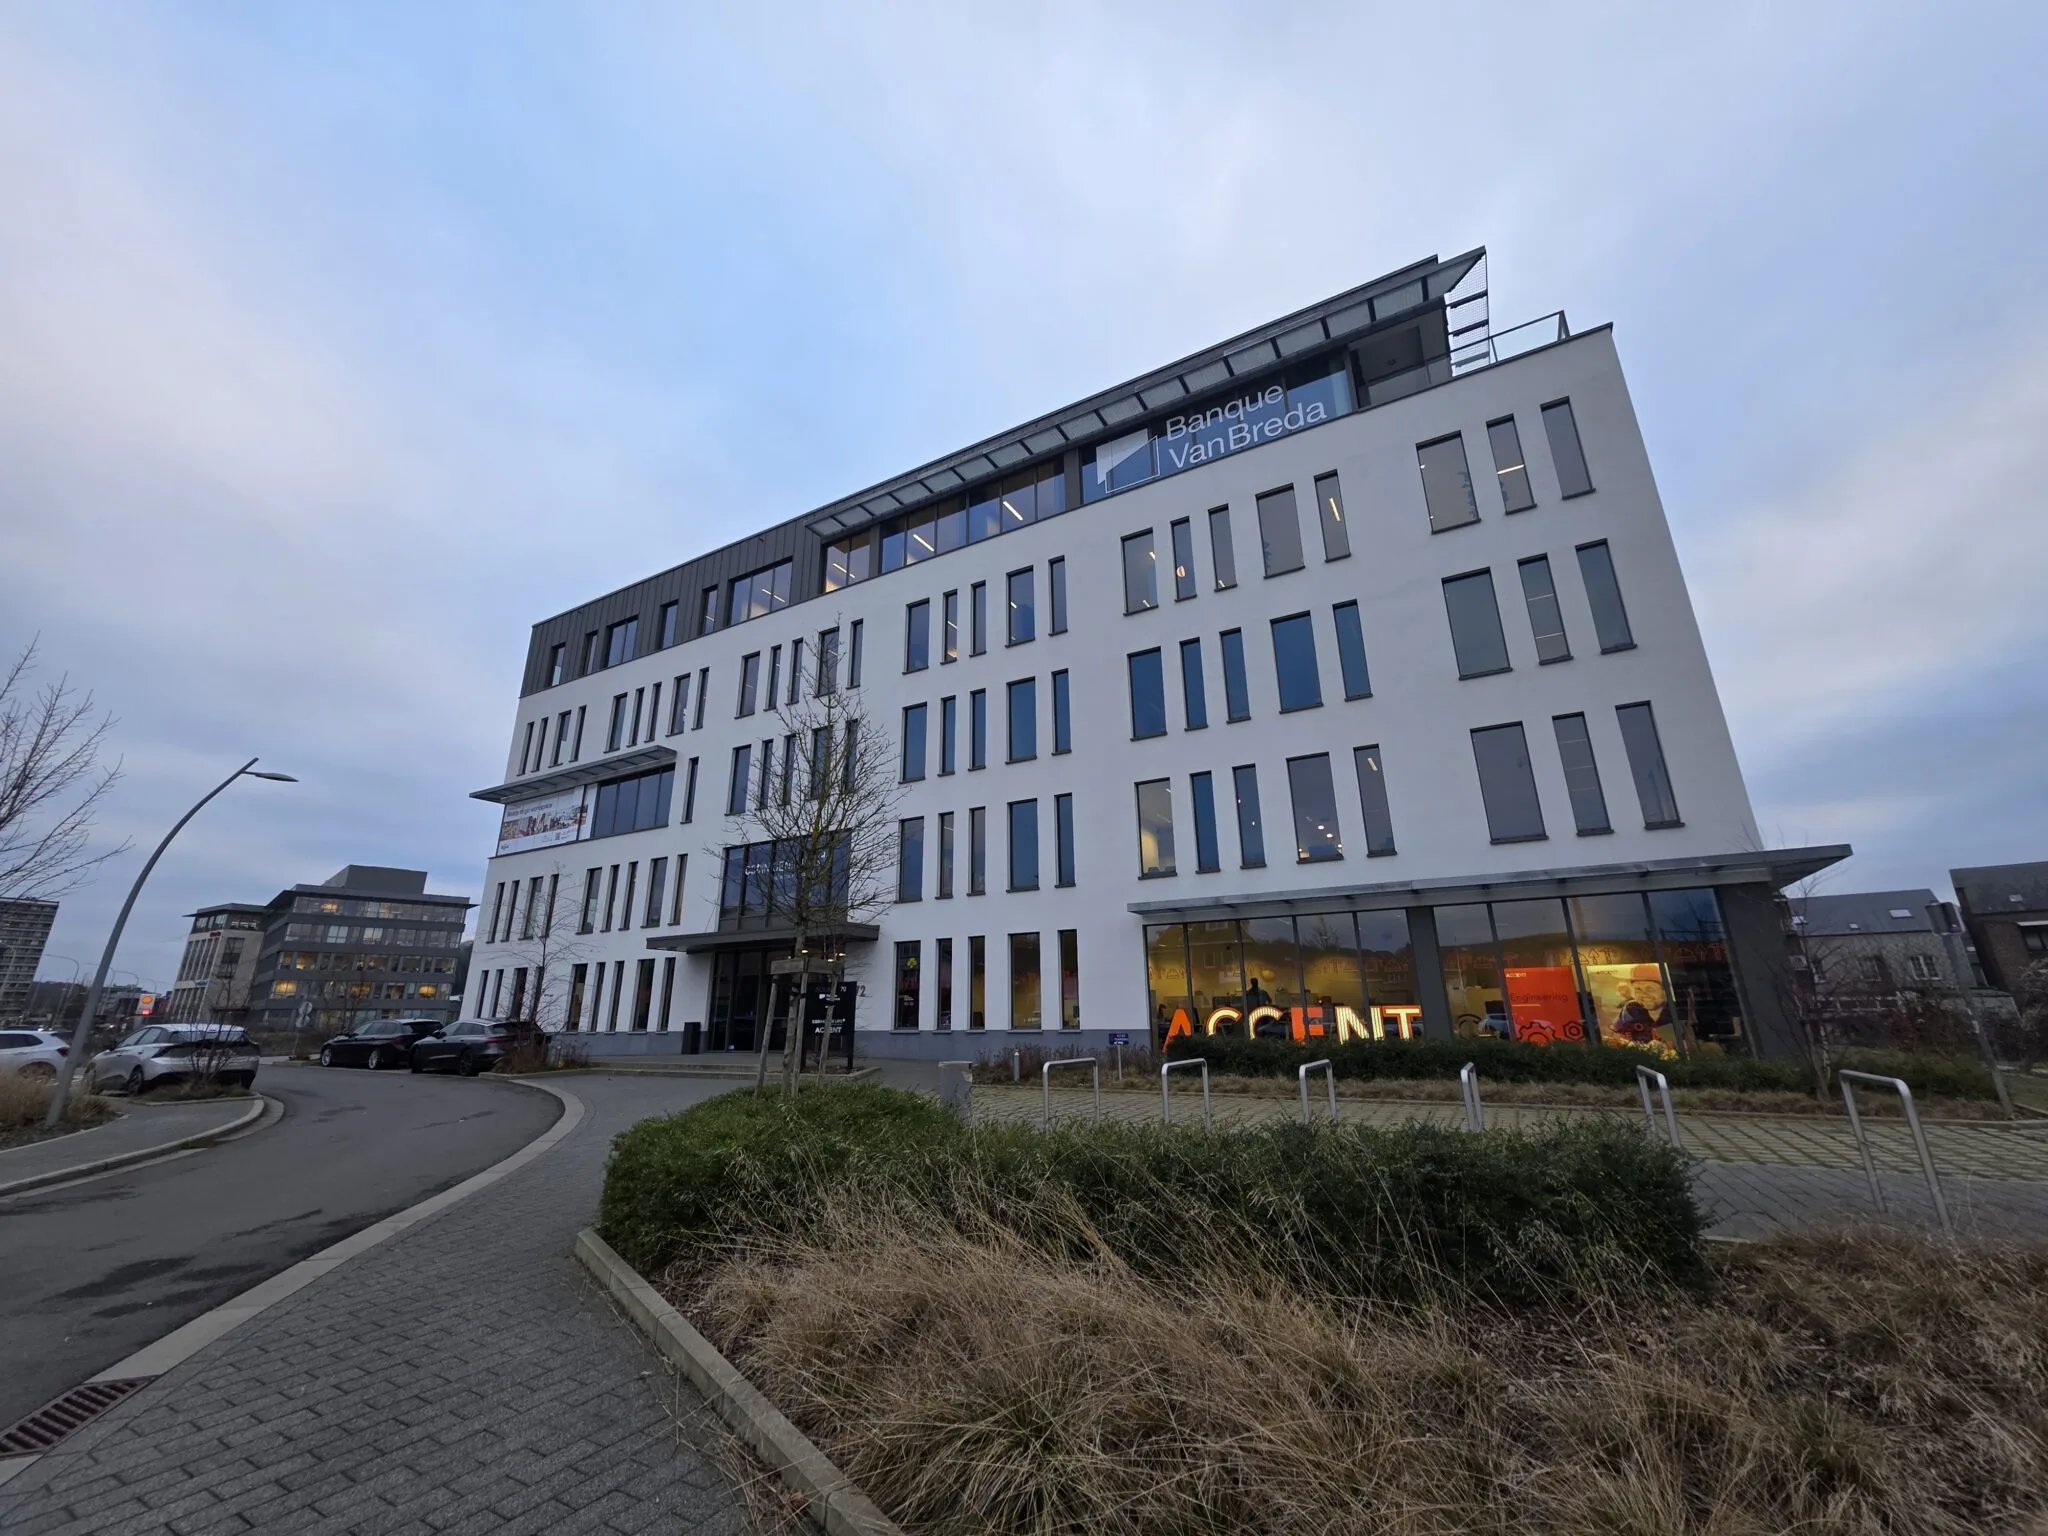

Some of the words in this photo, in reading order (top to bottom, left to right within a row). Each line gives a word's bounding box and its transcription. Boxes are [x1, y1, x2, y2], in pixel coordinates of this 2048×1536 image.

[1165, 385, 1284, 441] Banque
[1510, 992, 1568, 1003] Engineering
[815, 1026, 843, 1034] ACENT
[1162, 1004, 1423, 1053] ACCENT
